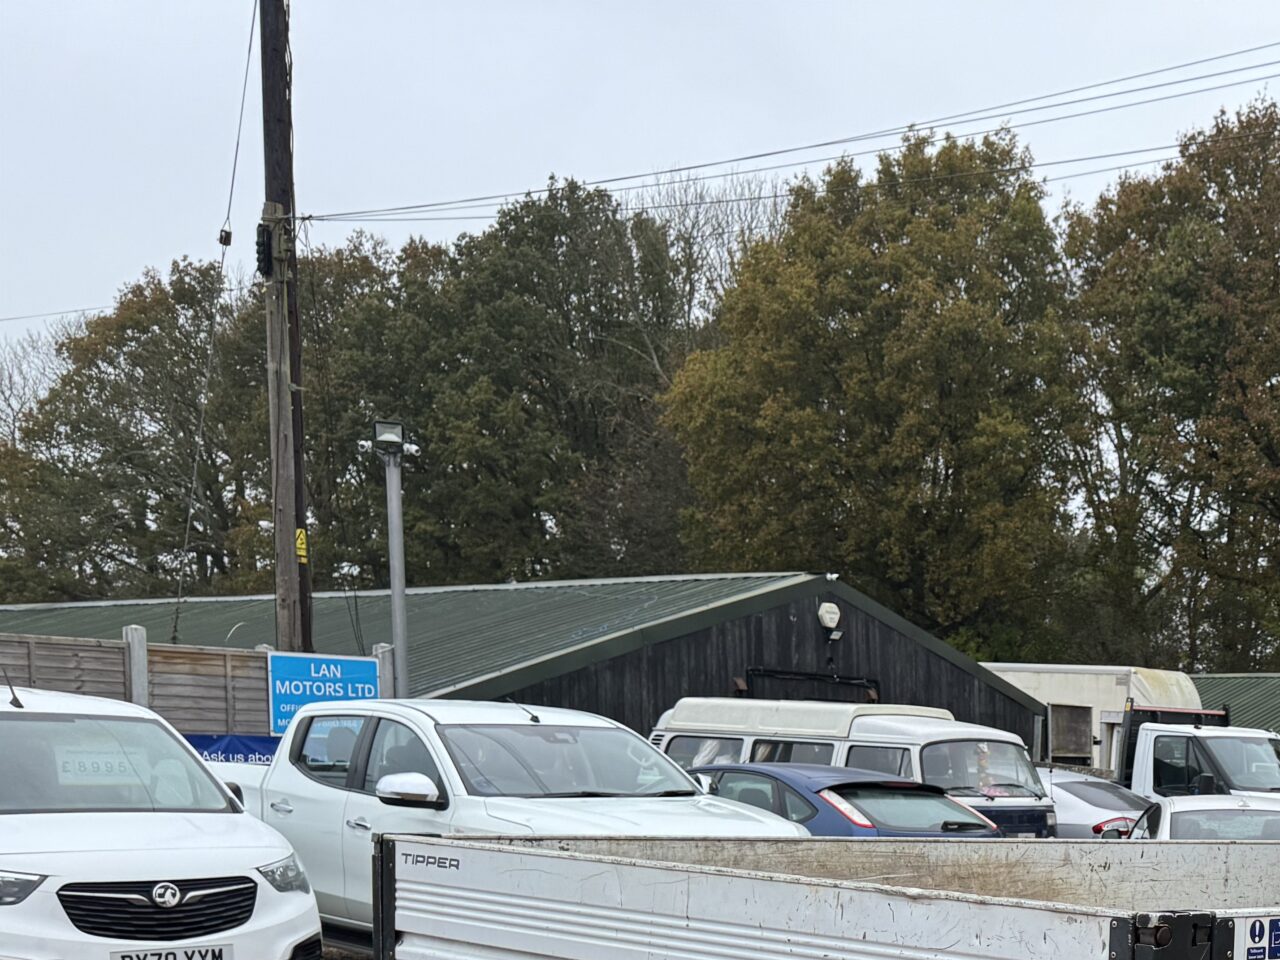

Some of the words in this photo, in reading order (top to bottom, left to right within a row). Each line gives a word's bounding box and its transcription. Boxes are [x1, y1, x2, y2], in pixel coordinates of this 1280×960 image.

[310, 663, 342, 678] LAN
[275, 680, 344, 696] MOTORS
[347, 683, 375, 697] LTD
[280, 703, 302, 713] OFFI
[203, 750, 226, 762] Ask
[229, 753, 245, 763] us
[248, 751, 275, 764] abo
[401, 852, 460, 870] TIPPER
